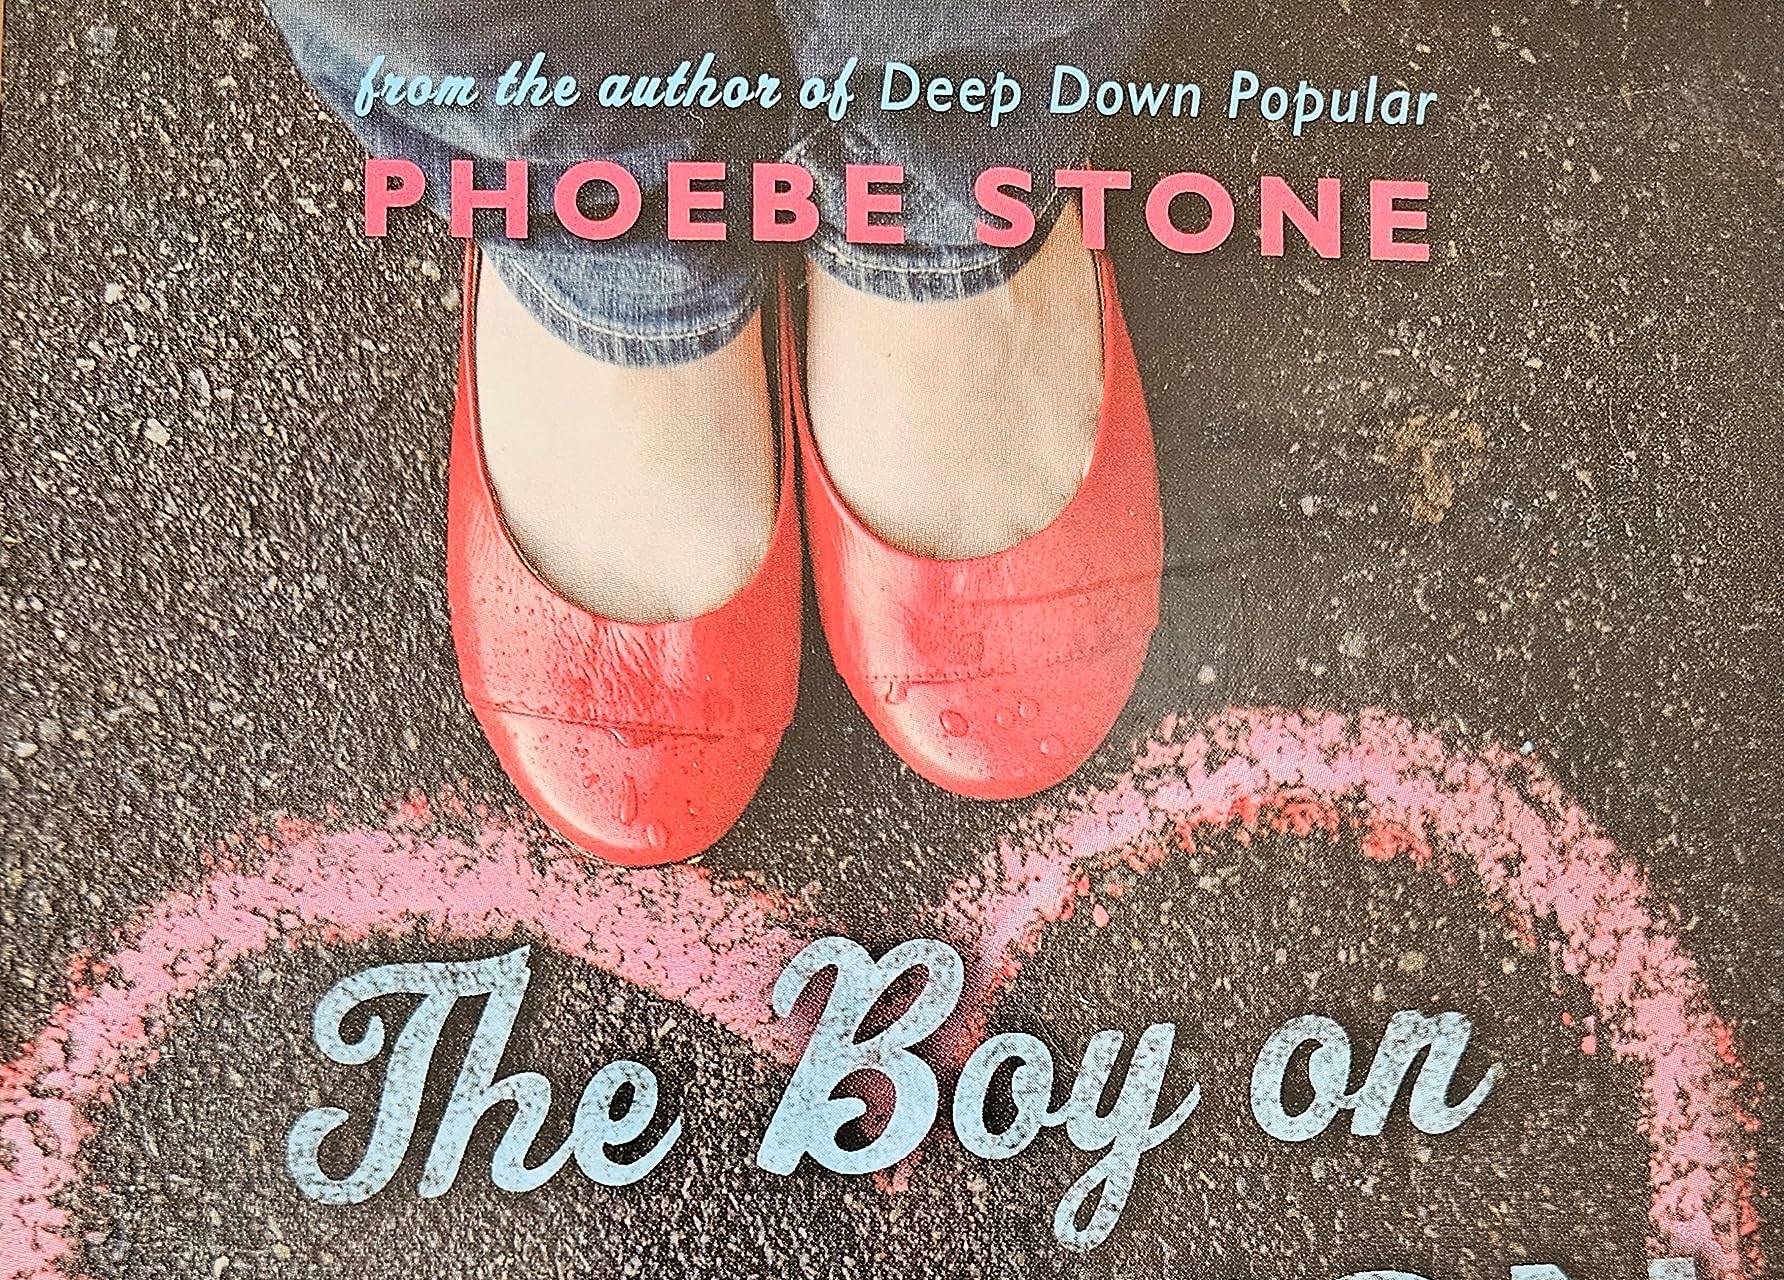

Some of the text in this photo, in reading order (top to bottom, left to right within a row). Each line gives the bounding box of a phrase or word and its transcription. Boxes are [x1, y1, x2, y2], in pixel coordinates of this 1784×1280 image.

[353, 51, 1438, 136] from the author of Deep Down Popular
[364, 159, 1431, 262] PHOEBE STONE
[286, 936, 1503, 1253] The Boy on
